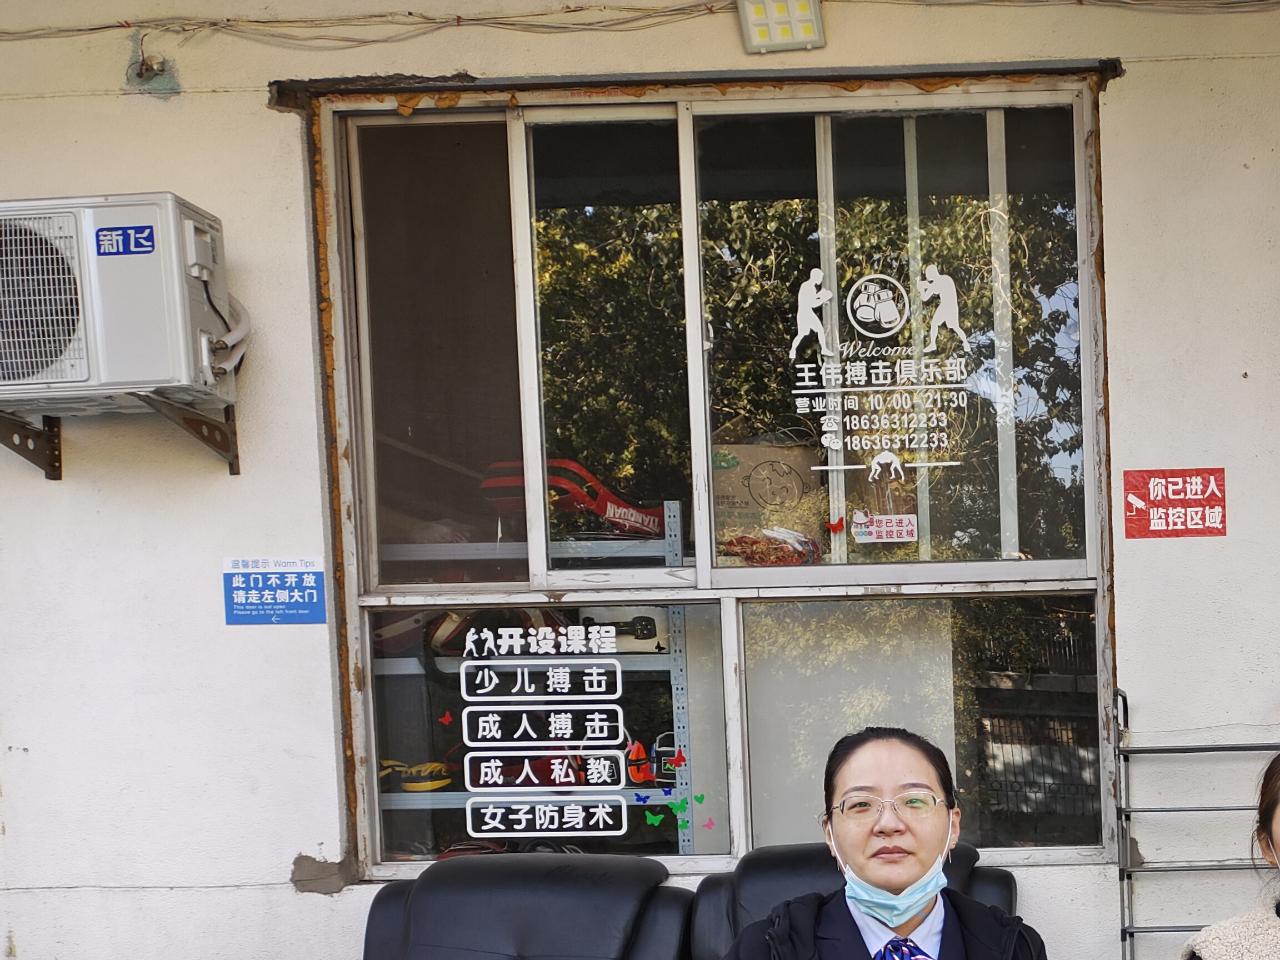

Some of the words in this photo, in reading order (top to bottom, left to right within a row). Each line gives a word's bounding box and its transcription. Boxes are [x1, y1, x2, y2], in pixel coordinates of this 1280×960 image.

[98, 228, 153, 254] 新飞
[839, 340, 916, 358] Welcome
[795, 358, 968, 387] 王伟搏击俱乐部
[795, 396, 859, 414] 营业时间
[843, 412, 948, 431] 18636312233
[844, 432, 949, 451] 18636312233
[1149, 506, 1223, 530] 监控区域
[232, 573, 317, 588] 此门不开放
[232, 589, 317, 604] 请走左侧大门
[497, 626, 617, 655] 开设课程
[475, 667, 608, 693] 少儿搏击
[477, 712, 609, 739] 成人搏击
[479, 757, 612, 785] 成人私教
[480, 804, 614, 831] 女子防身术
